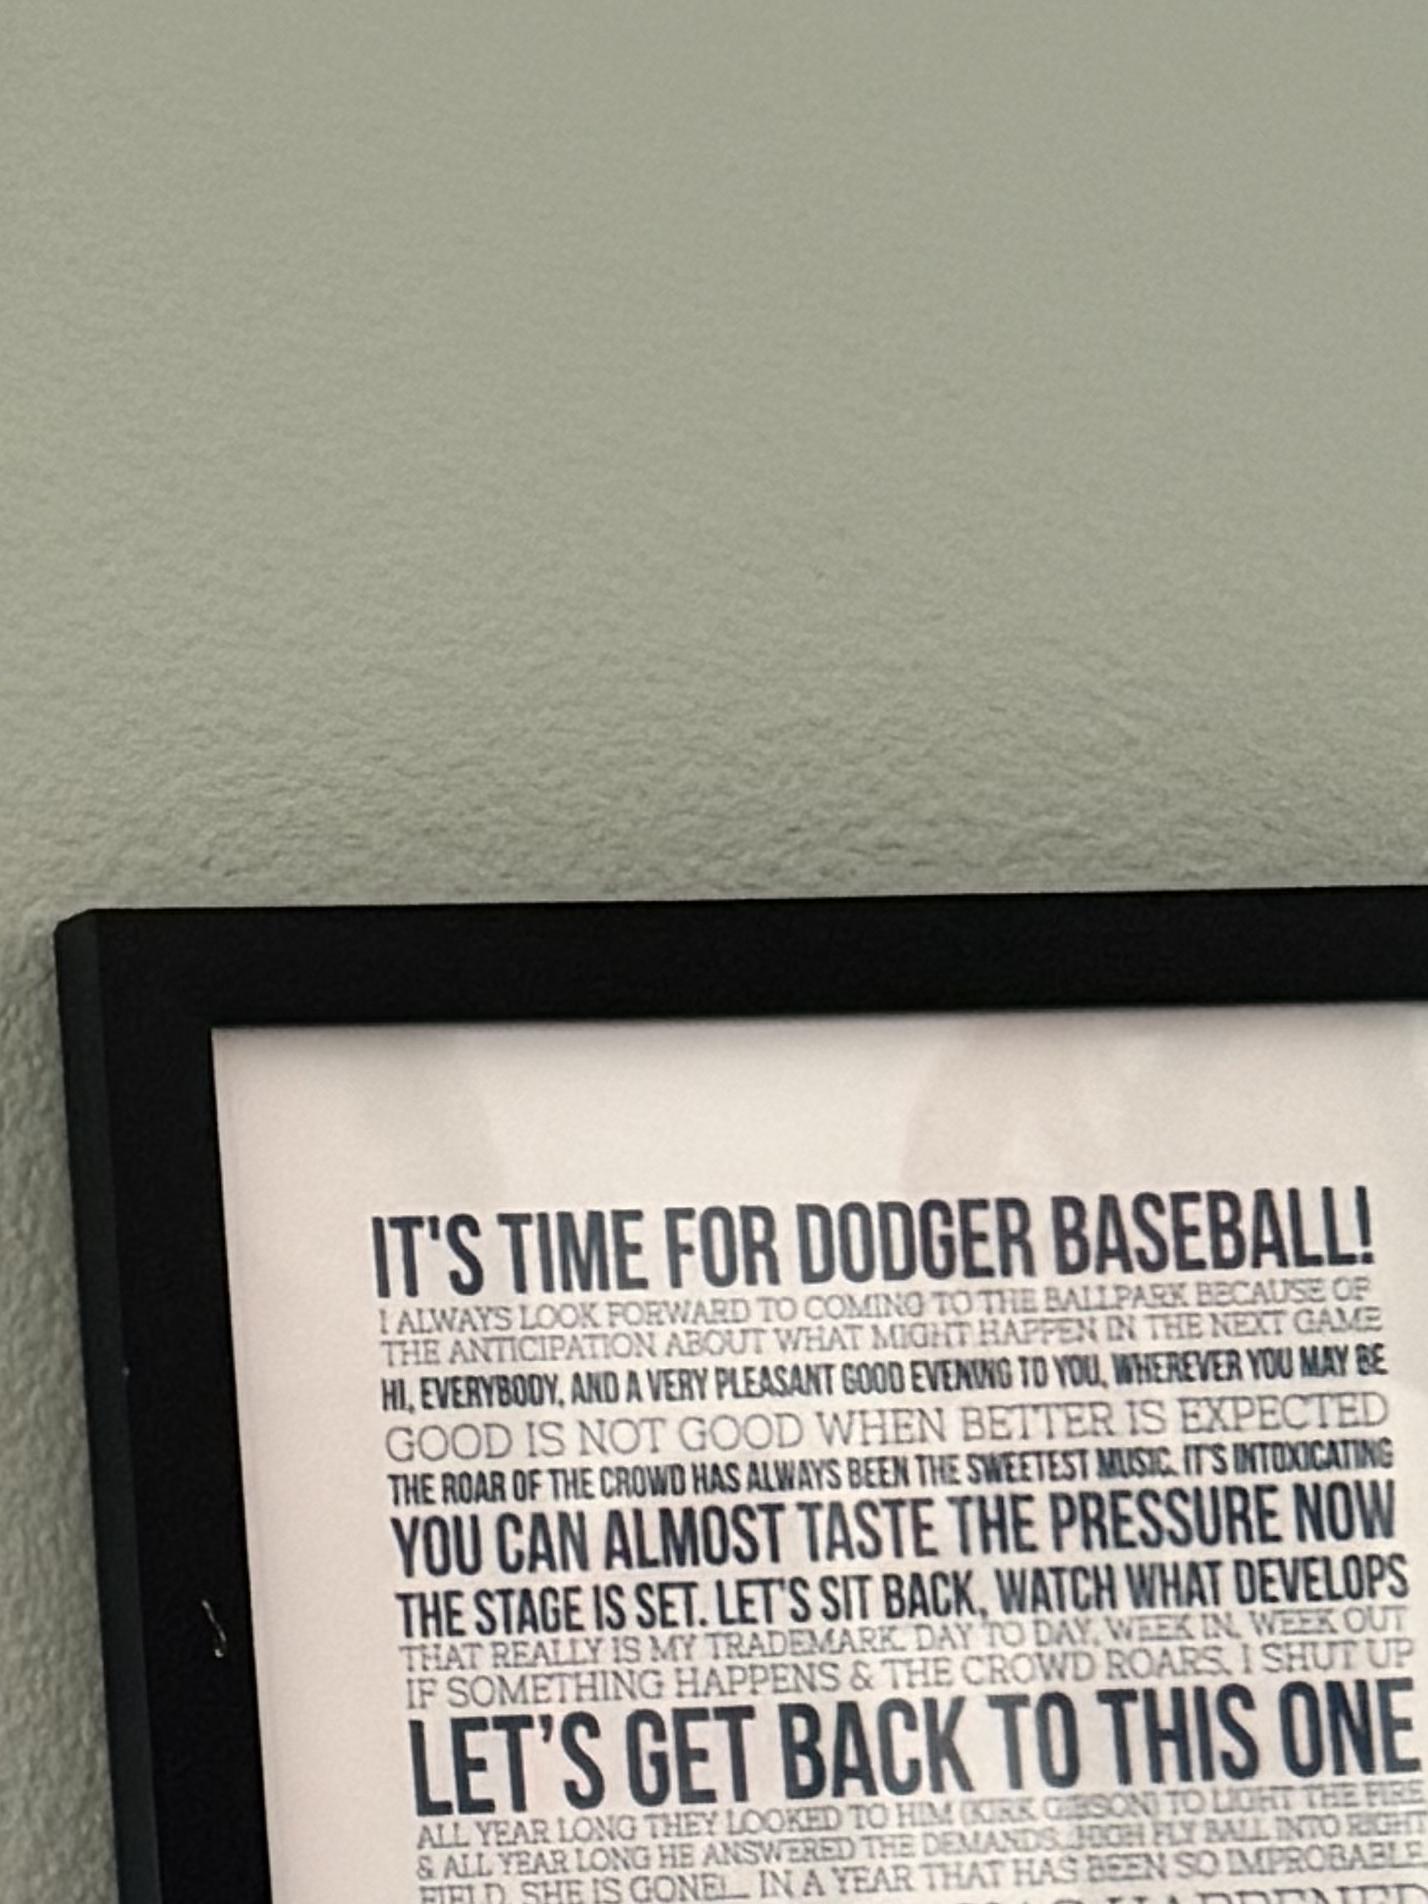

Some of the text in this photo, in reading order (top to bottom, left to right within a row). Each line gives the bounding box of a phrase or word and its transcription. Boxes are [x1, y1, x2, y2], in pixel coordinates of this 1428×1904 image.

[370, 1183, 1375, 1300] IT'S TIME FOR DODGER BASEBALL!
[377, 1294, 799, 1336] I ALWAYS LOOK FORWARD TO
[379, 1322, 865, 1369] THE ANTICIPATION ABOUT WHAT
[568, 1369, 621, 1405] AND
[623, 1368, 642, 1404] A
[645, 1365, 710, 1403] VERY
[713, 1361, 835, 1401] PLEASANT
[839, 1359, 906, 1396] GOOD
[383, 1388, 1391, 1464] GOOD IS NOT GOOD WHEN BETTER IS EXPECTED
[388, 1451, 961, 1507] THE ROAR OF THE CROWD HAS ALWAYS BEEN THE
[391, 1477, 1399, 1579] YOU CAN ALMOST TASTE THE PRESSURE NOW
[396, 1589, 467, 1640] THE
[471, 1584, 585, 1637] STAGE
[590, 1582, 627, 1632] IS
[632, 1579, 706, 1630] SET.
[714, 1575, 812, 1627] LET'S
[817, 1572, 873, 1623] SIT
[994, 1562, 1119, 1616] WATCH
[1124, 1558, 1224, 1610] WHAT
[1231, 1550, 1410, 1606] DEVELOPS
[404, 1675, 440, 1711] IF
[444, 1666, 665, 1710] SOMETHING
[672, 1658, 842, 1700] HAPPENS
[880, 1654, 954, 1691] THE
[959, 1647, 1098, 1687] CROWD
[407, 1674, 1421, 1818] LET'S GET BACK TO THIS ONE
